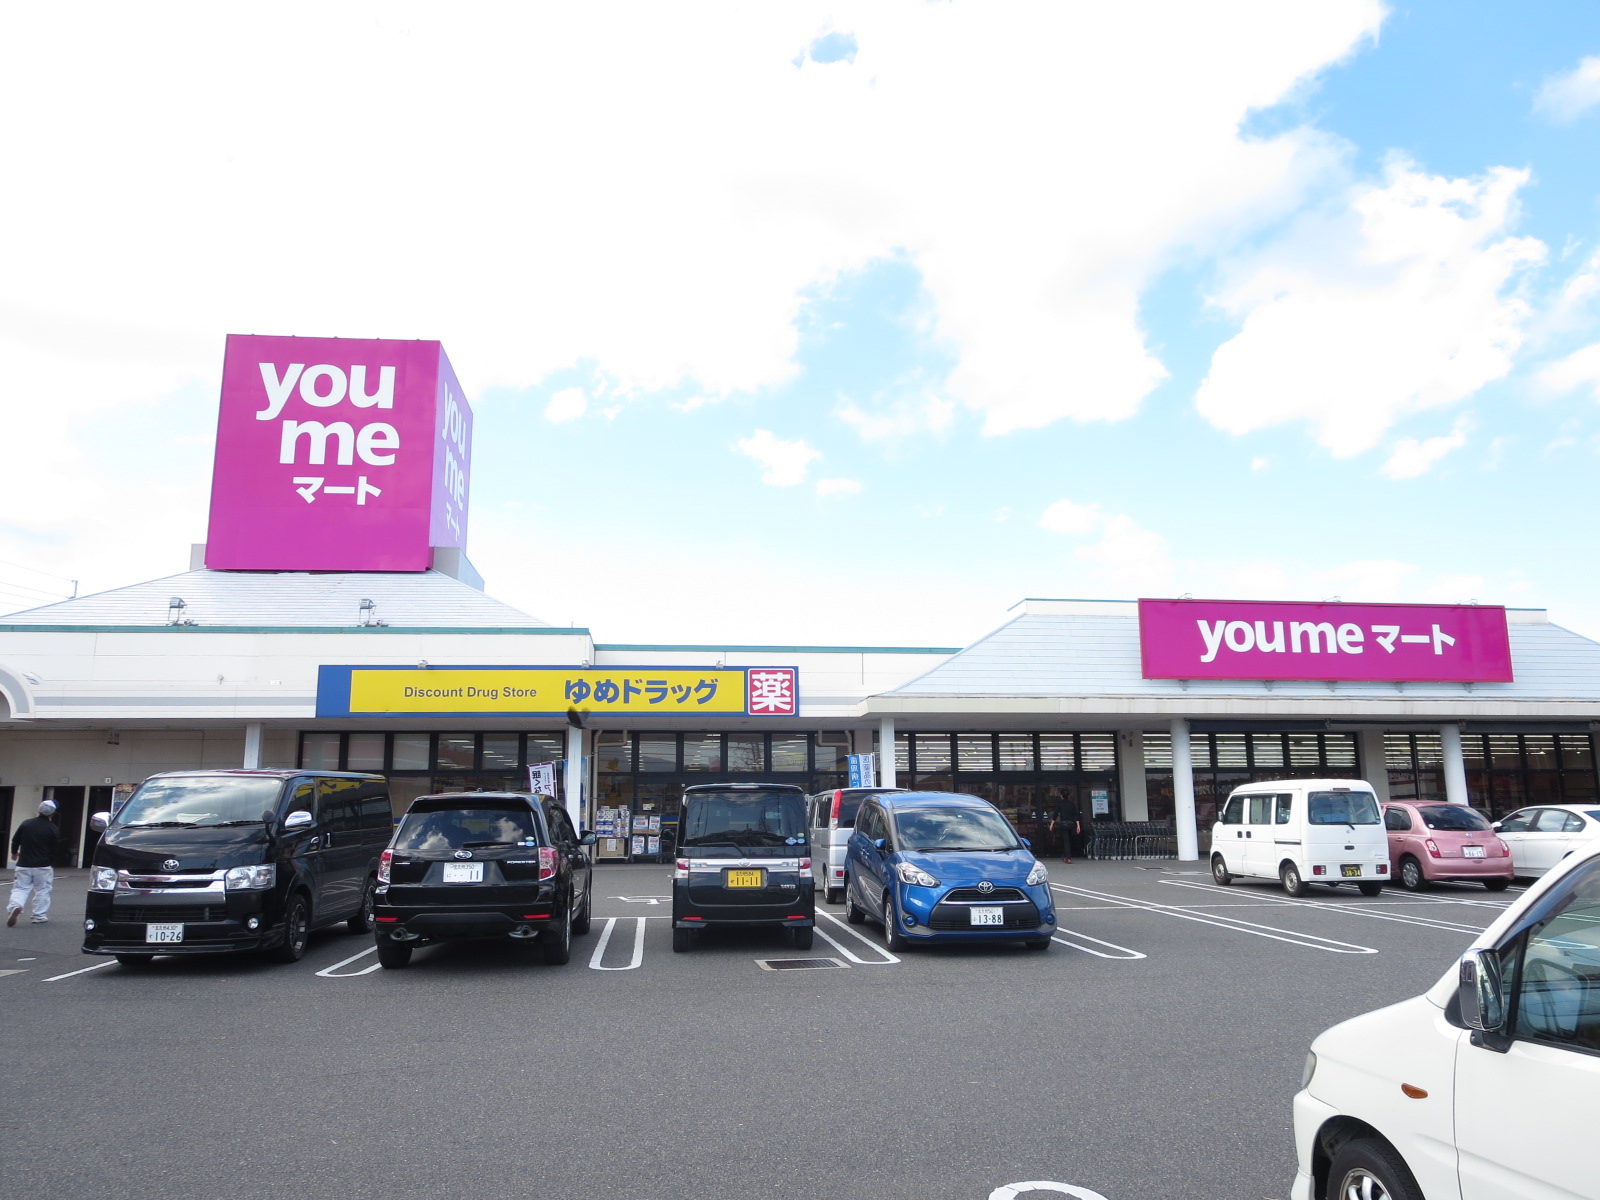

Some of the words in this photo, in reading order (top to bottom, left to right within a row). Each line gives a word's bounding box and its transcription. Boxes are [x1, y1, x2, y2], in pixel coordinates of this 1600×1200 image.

[256, 362, 396, 421] you
[441, 382, 466, 461] you
[279, 420, 400, 466] me
[292, 476, 382, 506] マート
[444, 445, 465, 511] me
[445, 503, 461, 541] マート
[1371, 624, 1456, 655] マート
[404, 686, 463, 698] Discount
[467, 686, 499, 700] Drug
[503, 686, 538, 698] Store
[564, 678, 719, 705] ゆめドラッグ
[751, 672, 792, 712] 薬
[736, 876, 758, 886] 11-11
[978, 914, 1002, 924] 13-88
[155, 931, 182, 942] 10-26
